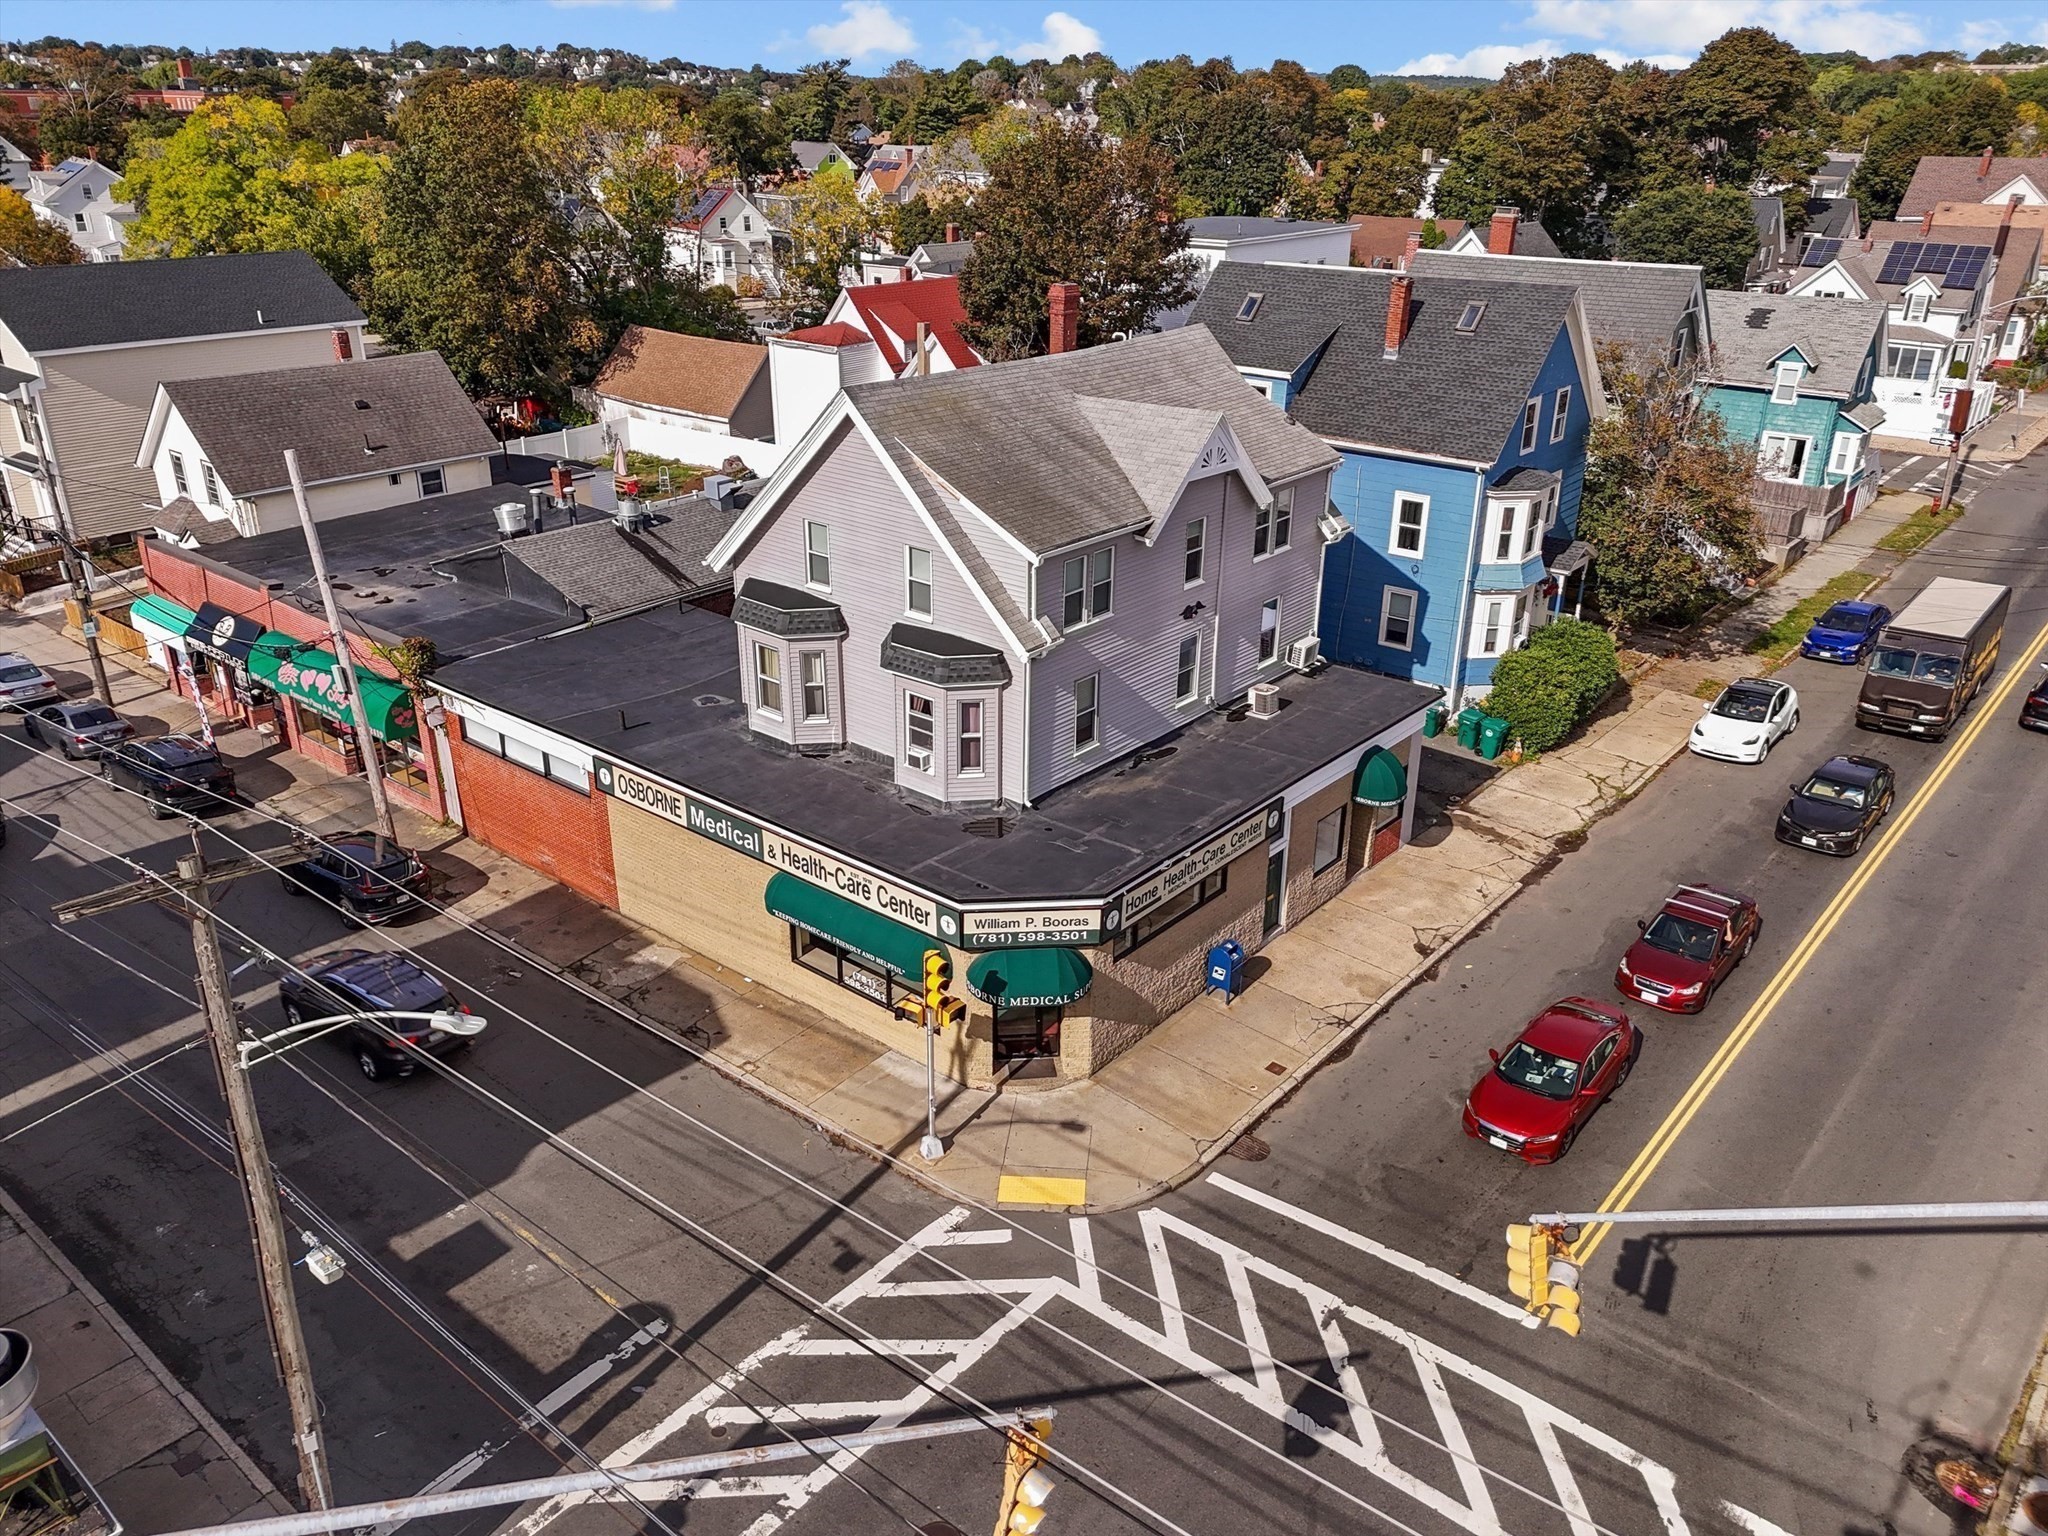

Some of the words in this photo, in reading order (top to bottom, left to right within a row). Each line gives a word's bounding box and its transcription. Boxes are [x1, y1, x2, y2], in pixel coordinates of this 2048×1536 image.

[617, 774, 682, 819] OSBORNE
[689, 805, 760, 853] Medical
[767, 844, 777, 861] &
[780, 843, 872, 901] Health-Care
[876, 884, 931, 927] Center
[1125, 885, 1159, 915] Home
[1163, 843, 1226, 891] Health-Care
[1230, 819, 1264, 848] Center
[974, 917, 1021, 930] William
[1025, 918, 1038, 928] P.
[1042, 916, 1090, 928] Booras
[799, 921, 832, 942] HOMECARE
[832, 935, 862, 955] FRIENDLY
[861, 951, 878, 966] AND
[972, 932, 1013, 945] (781)
[1017, 930, 1088, 943] 598-3501
[843, 976, 886, 1002] 598-3501
[852, 970, 877, 990] (781)
[1009, 994, 1071, 1007] MEDICAL
